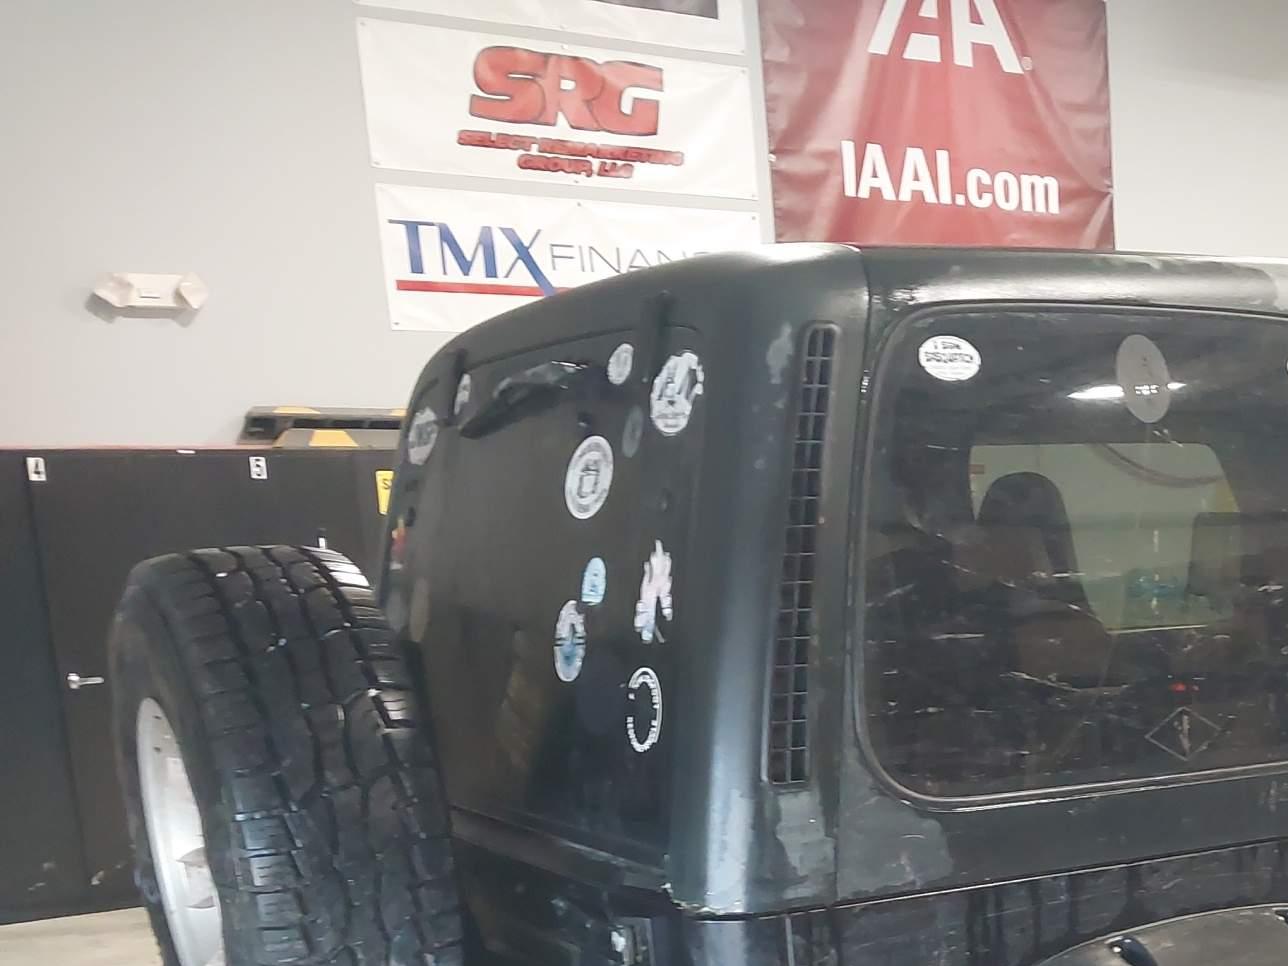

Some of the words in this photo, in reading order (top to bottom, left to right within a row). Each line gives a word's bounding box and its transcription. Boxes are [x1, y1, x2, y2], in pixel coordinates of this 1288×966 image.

[469, 46, 663, 136] SRG
[841, 140, 1060, 214] IAAI.com
[388, 219, 556, 297] TMX
[549, 243, 709, 273] FINAN
